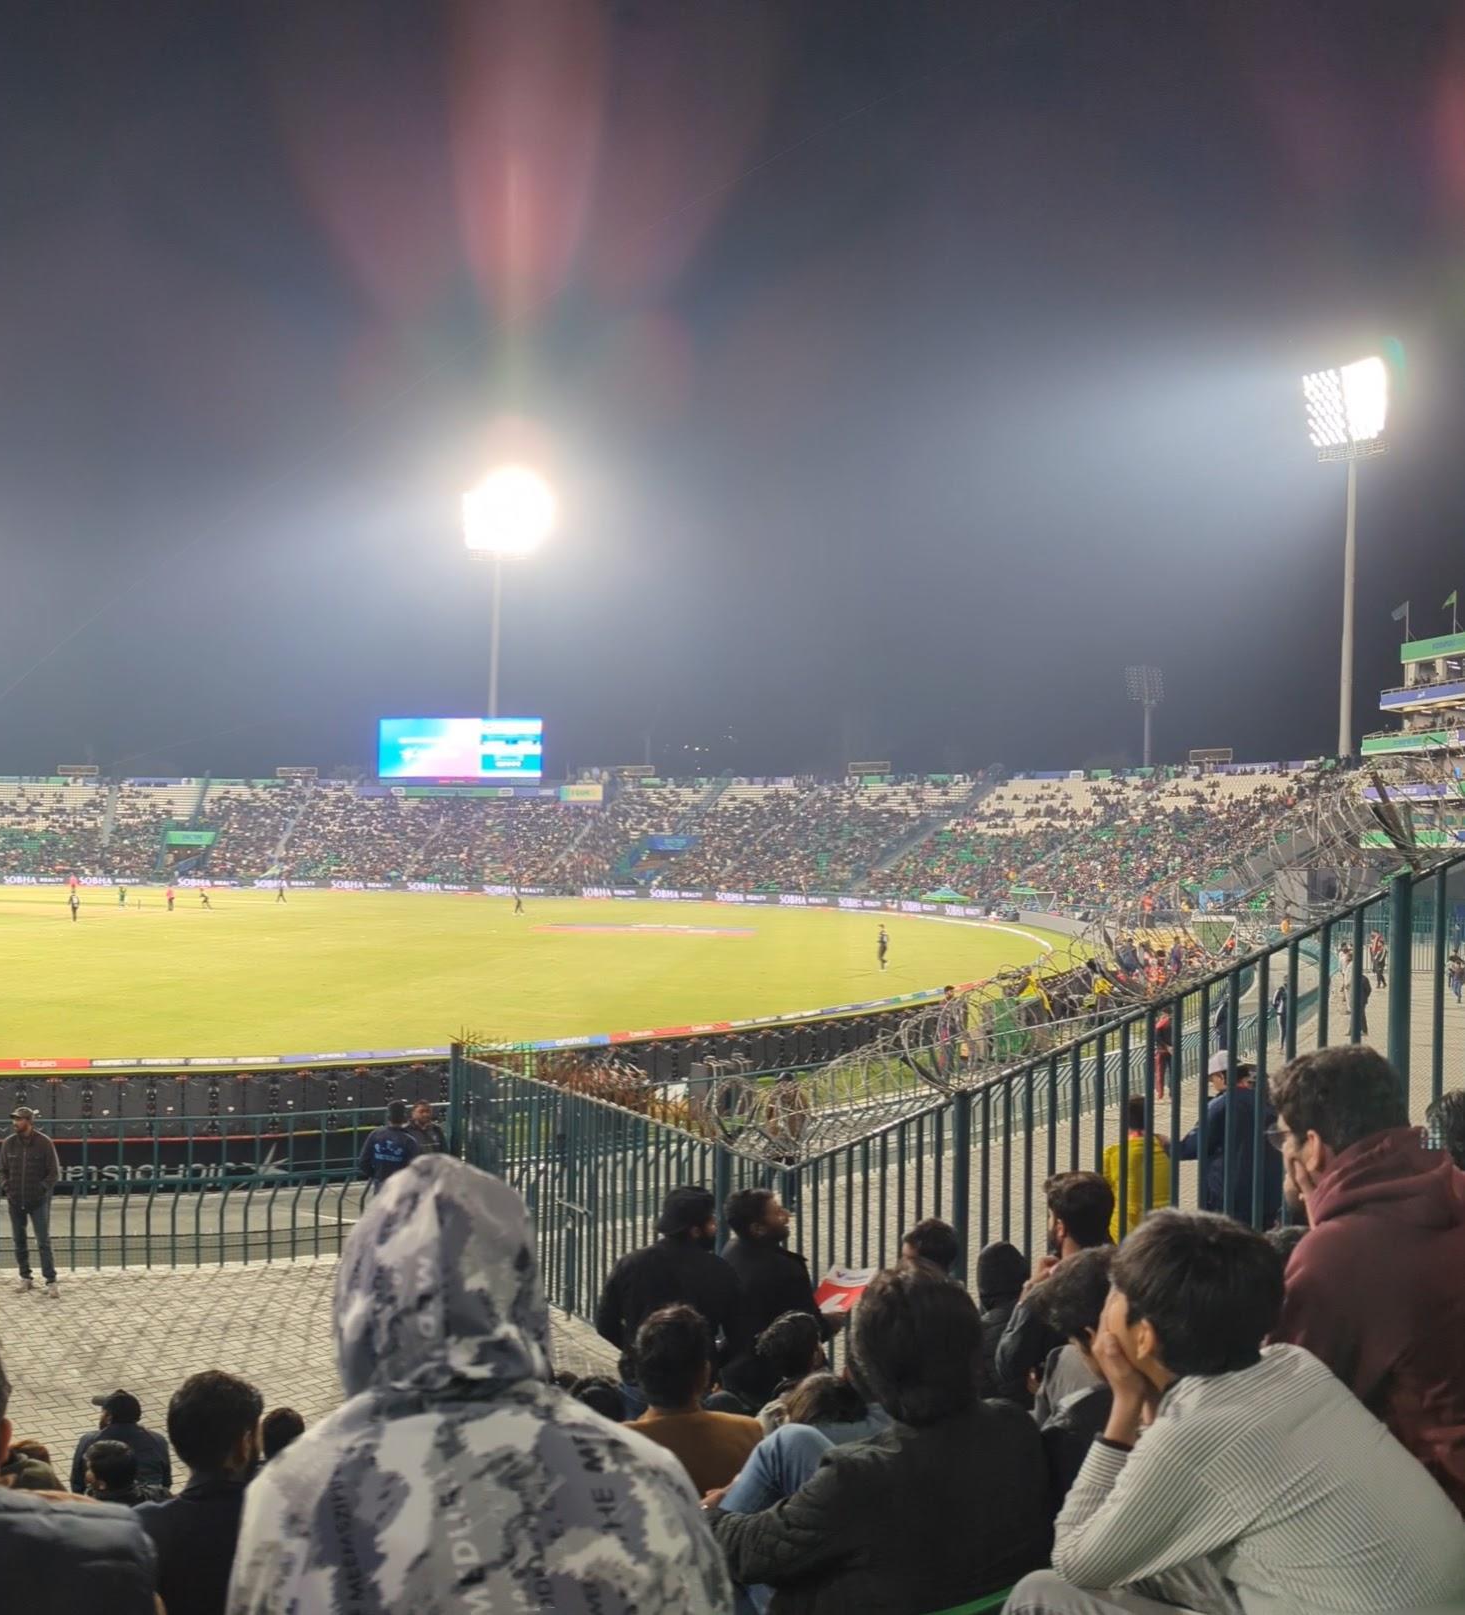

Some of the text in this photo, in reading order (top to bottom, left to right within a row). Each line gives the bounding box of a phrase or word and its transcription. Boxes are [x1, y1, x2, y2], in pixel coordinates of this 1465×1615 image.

[3, 876, 37, 885] SOBHA
[79, 876, 112, 886] SOBHA
[177, 877, 211, 887] SOBHA
[331, 880, 364, 890] SOBHA
[407, 881, 441, 892] SOBHA
[483, 884, 517, 895] SOBHA
[582, 887, 612, 897] SOBHA
[649, 888, 679, 899] SOBHA
[715, 891, 745, 902] SOBHA
[779, 894, 807, 905] SOBHA
